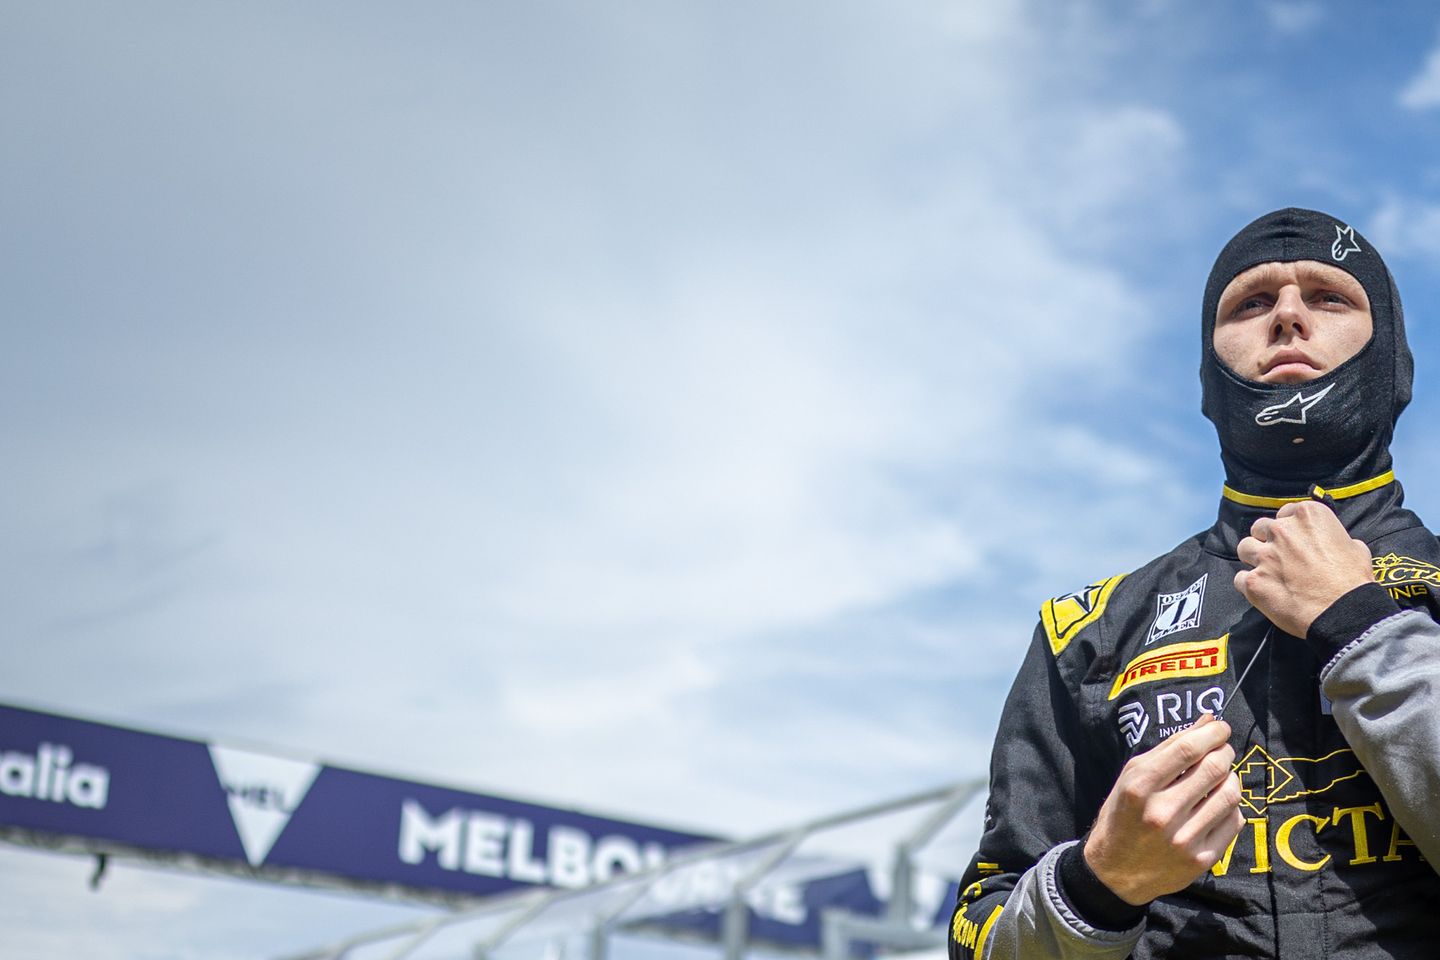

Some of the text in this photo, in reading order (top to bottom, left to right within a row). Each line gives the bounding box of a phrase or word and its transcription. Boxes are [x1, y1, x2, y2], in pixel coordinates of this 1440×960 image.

[1388, 584, 1428, 600] ING
[1121, 647, 1219, 688] PIRELLI
[1157, 687, 1224, 724] RIQ
